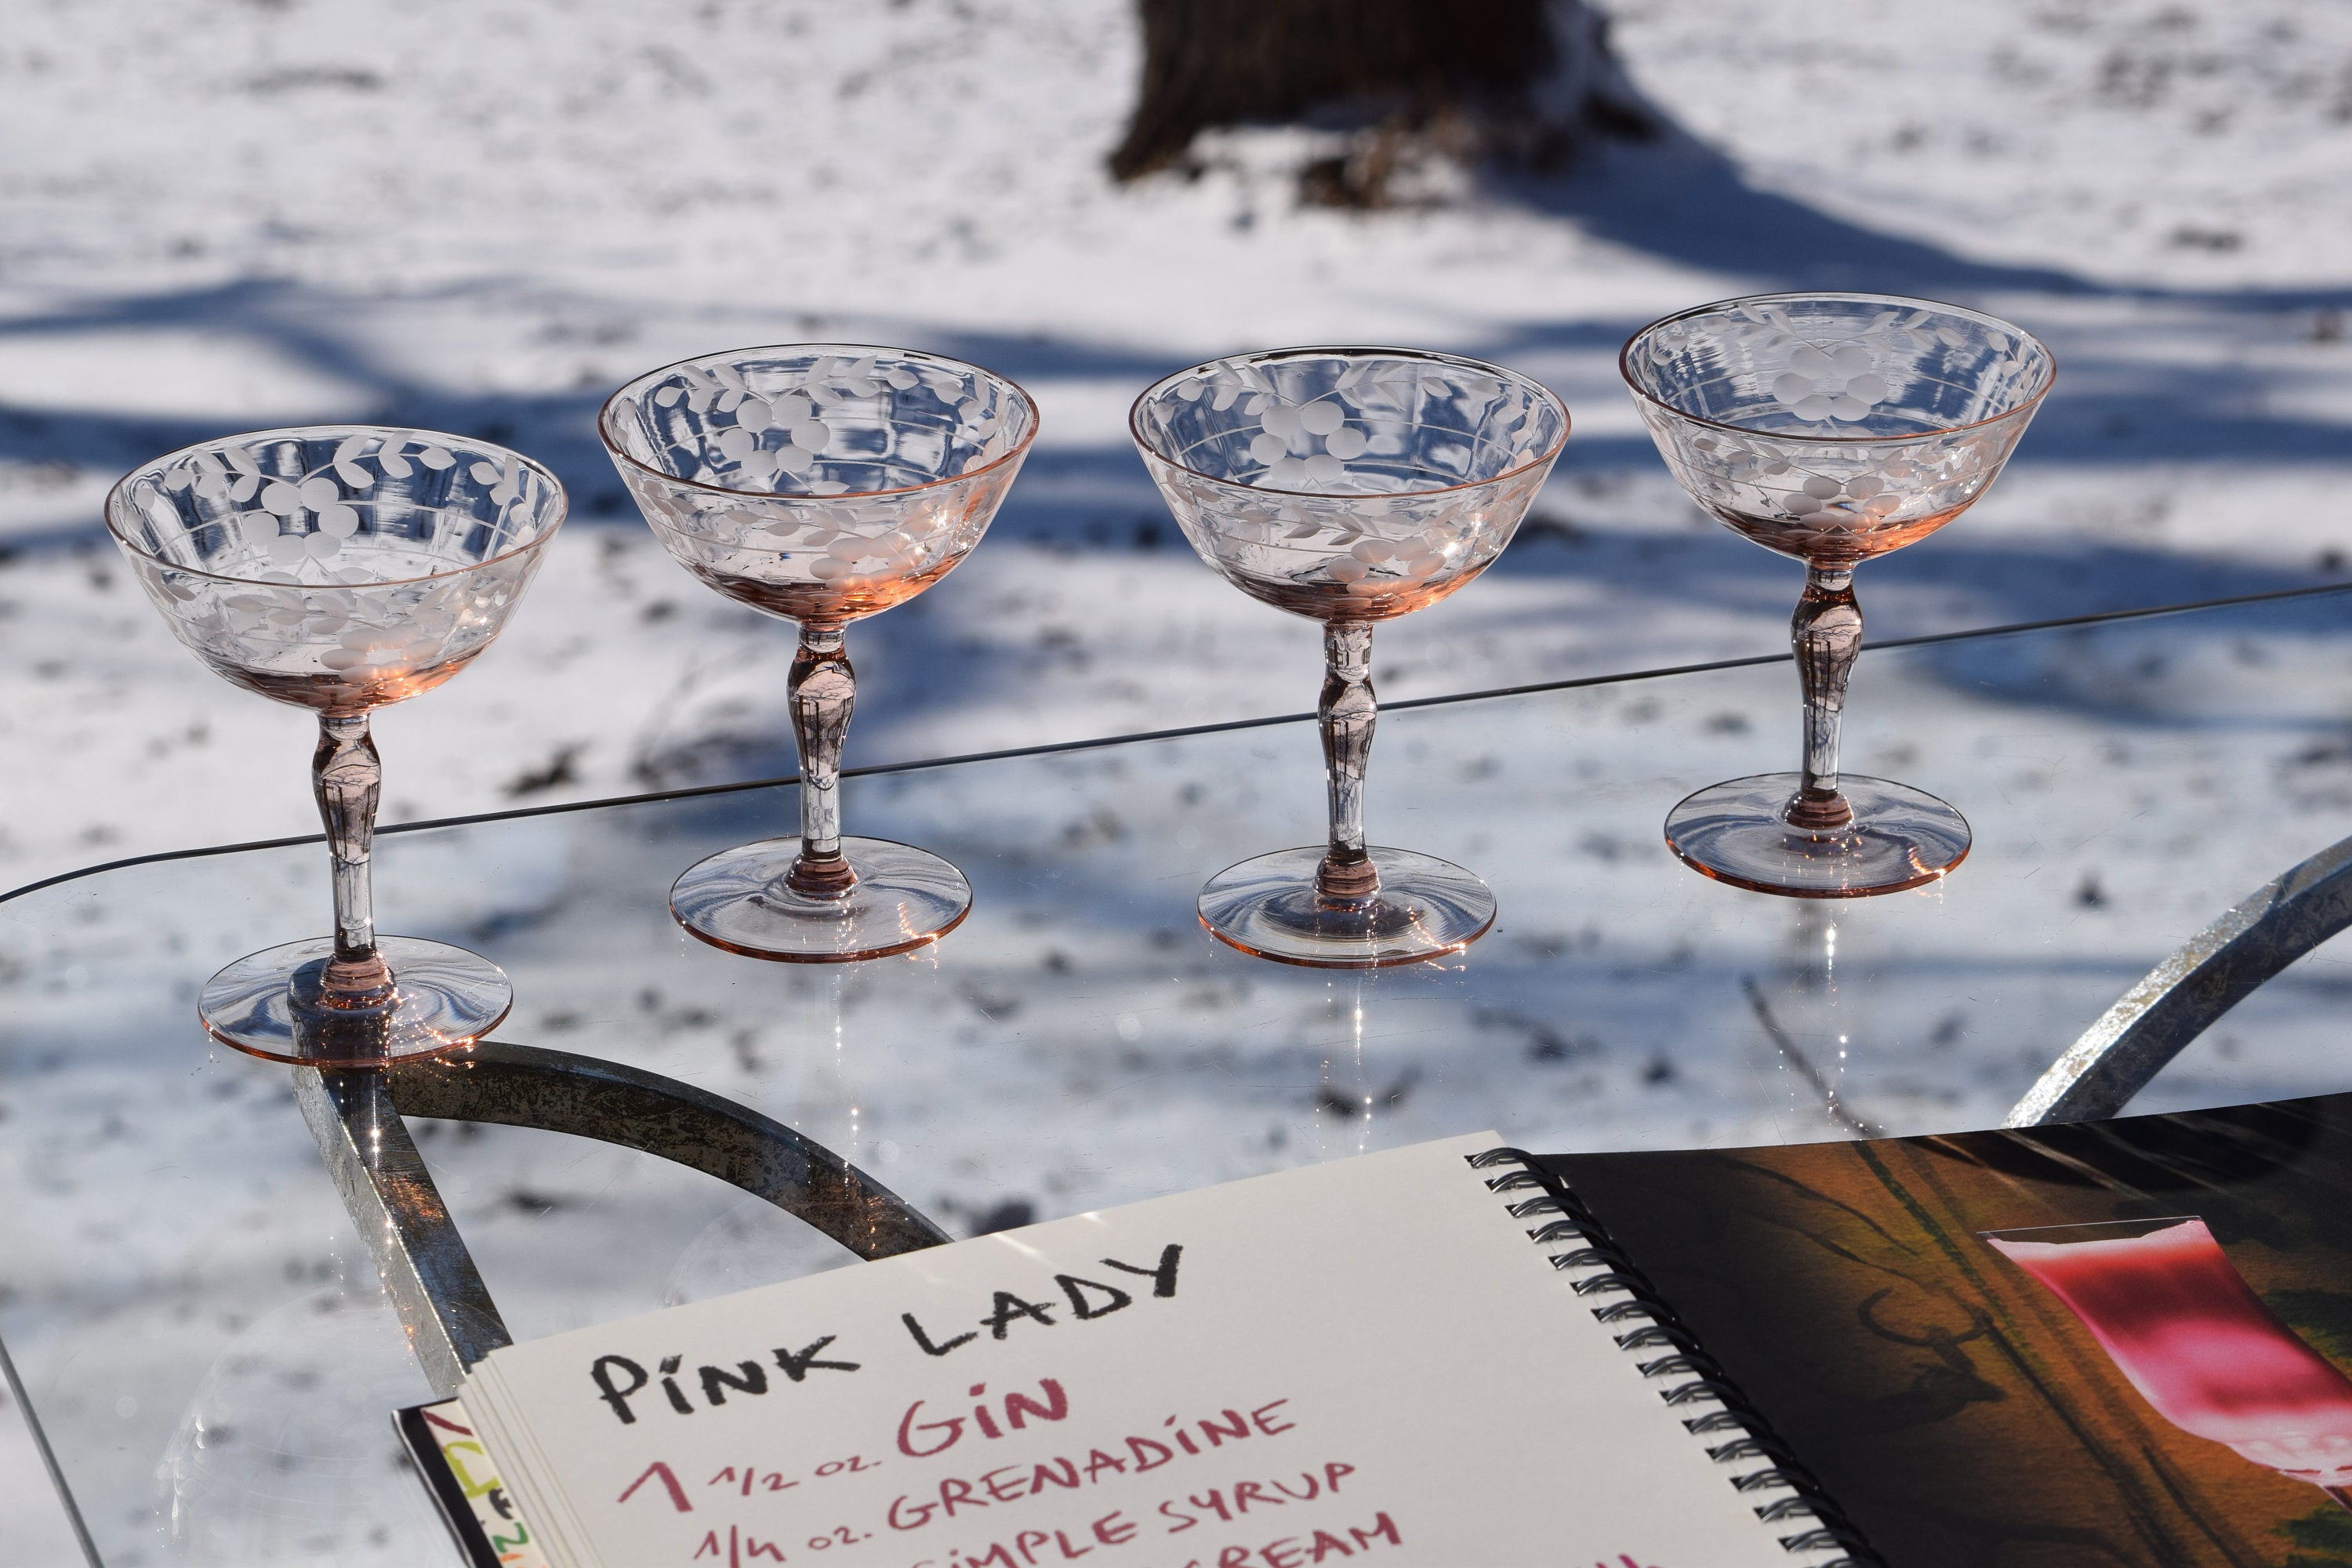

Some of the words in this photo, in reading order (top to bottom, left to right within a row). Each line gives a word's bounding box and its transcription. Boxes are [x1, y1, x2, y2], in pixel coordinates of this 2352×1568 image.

[902, 1243, 1184, 1356] LADY
[617, 1461, 694, 1513] 1
[708, 1466, 799, 1497] 1/2
[1159, 1461, 1356, 1534] SYRUP
[1181, 1511, 1402, 1568] REAM
